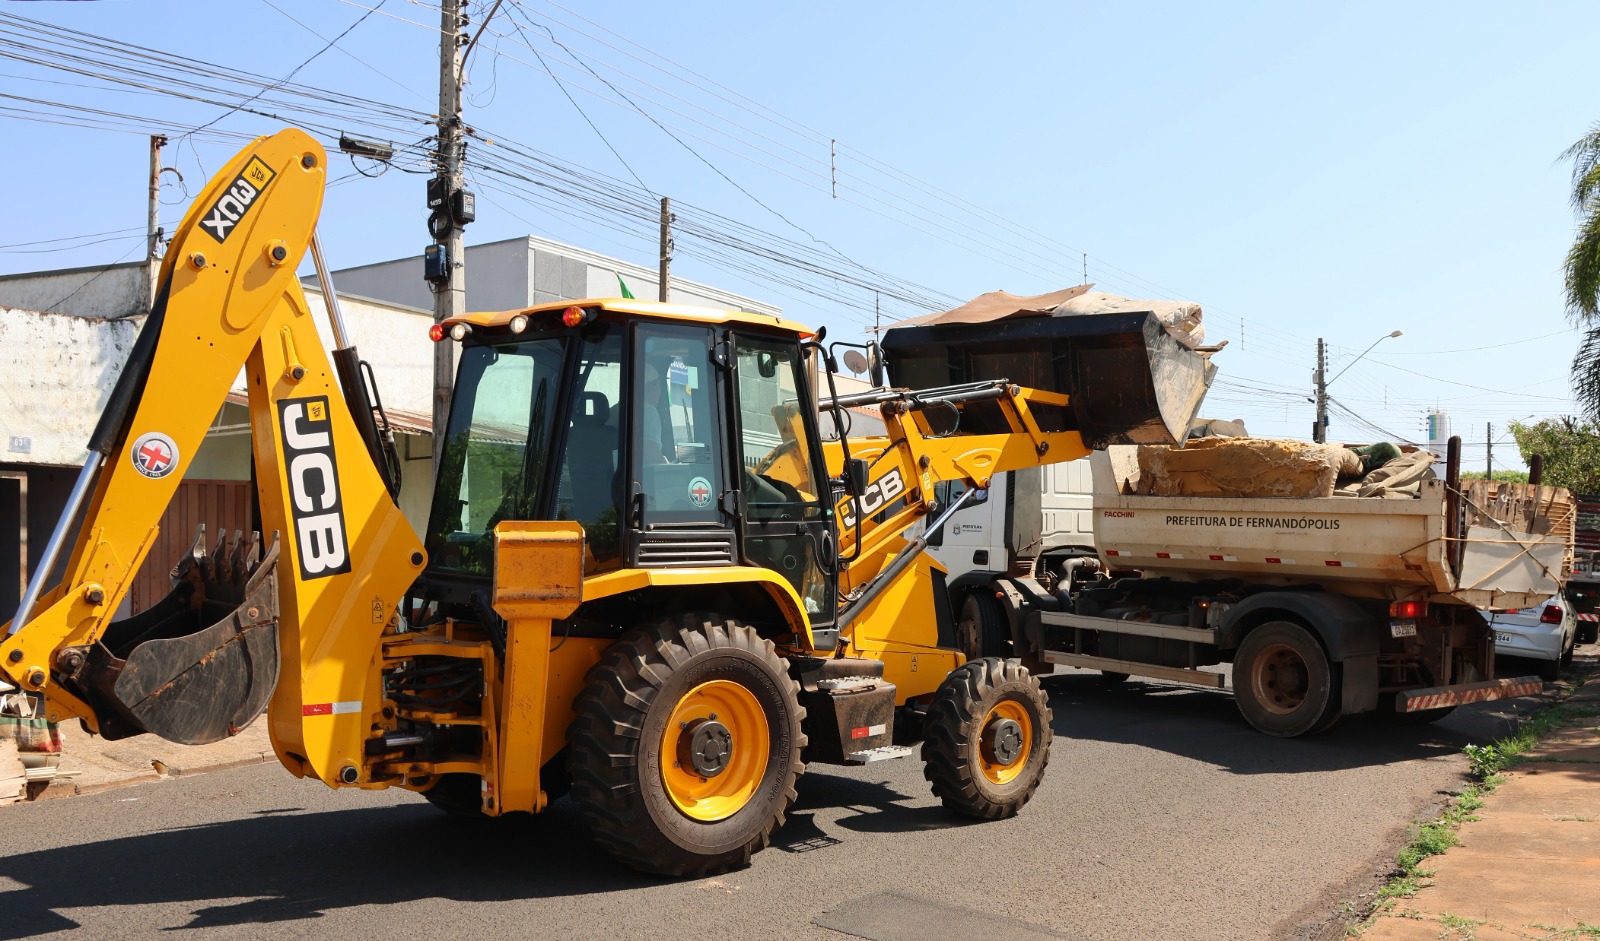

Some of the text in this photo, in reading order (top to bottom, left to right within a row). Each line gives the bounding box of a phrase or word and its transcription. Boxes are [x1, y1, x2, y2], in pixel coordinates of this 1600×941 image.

[251, 166, 266, 182] JCB
[202, 179, 257, 240] 3CX
[283, 403, 345, 574] JCB
[843, 470, 904, 527] JCB
[1165, 515, 1340, 530] PREFEITURA DE FERNANDÓPOLIS
